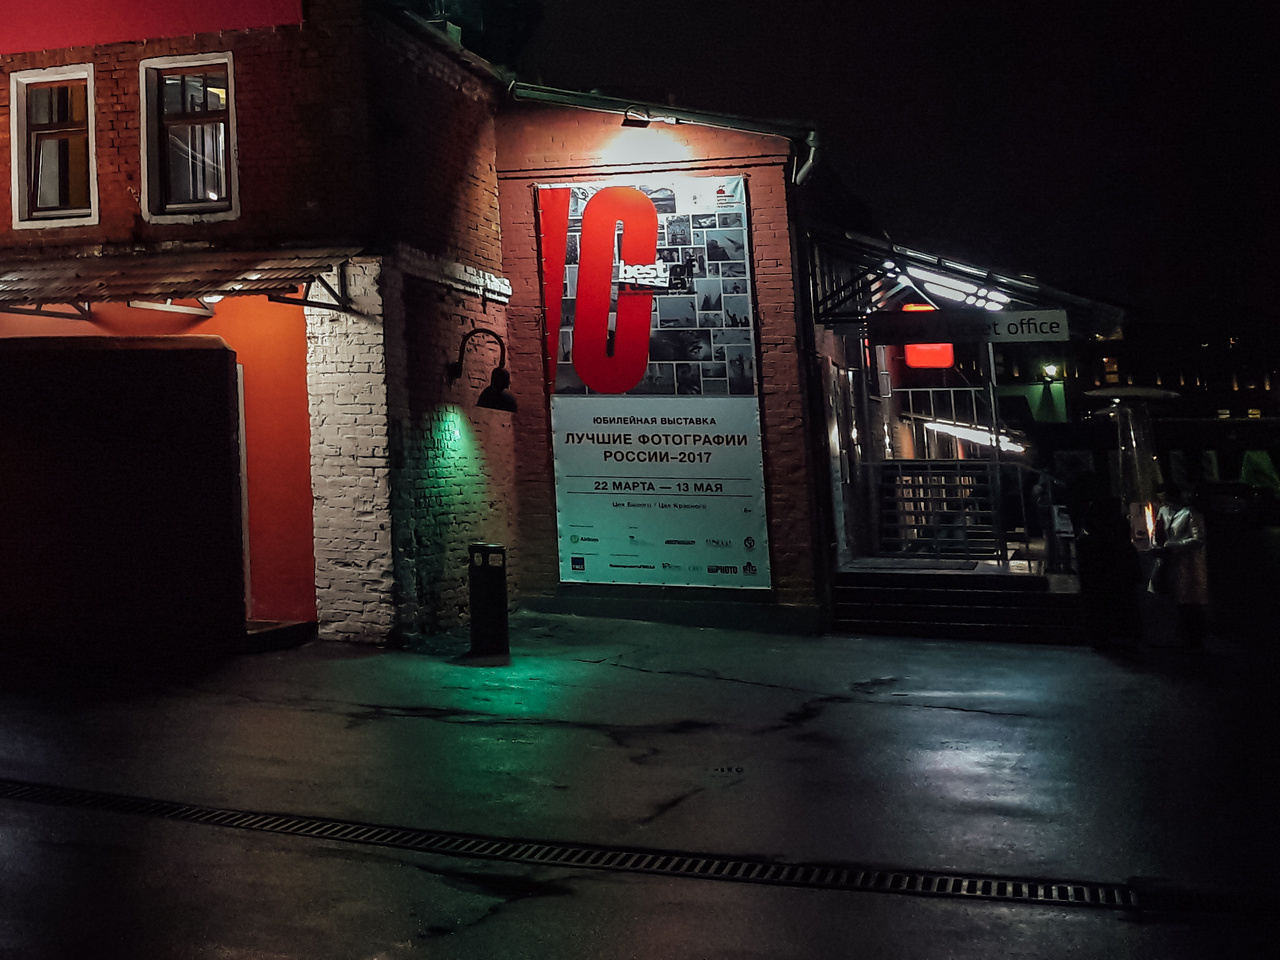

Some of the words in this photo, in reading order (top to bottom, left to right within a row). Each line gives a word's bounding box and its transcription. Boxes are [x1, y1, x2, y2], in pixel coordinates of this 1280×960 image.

[619, 259, 670, 279] best
[1008, 318, 1060, 335] office
[593, 416, 657, 425] ЮБИЛЕЙНАЯ
[660, 417, 716, 425] ВЫСТАВКА
[565, 433, 632, 445] ЛУЧШИЕ
[638, 434, 747, 446] ФОТОГРАФИИ
[594, 481, 608, 490] 22
[612, 482, 655, 491] МАРТА
[676, 483, 689, 492] 13
[694, 483, 723, 492] МАЯ
